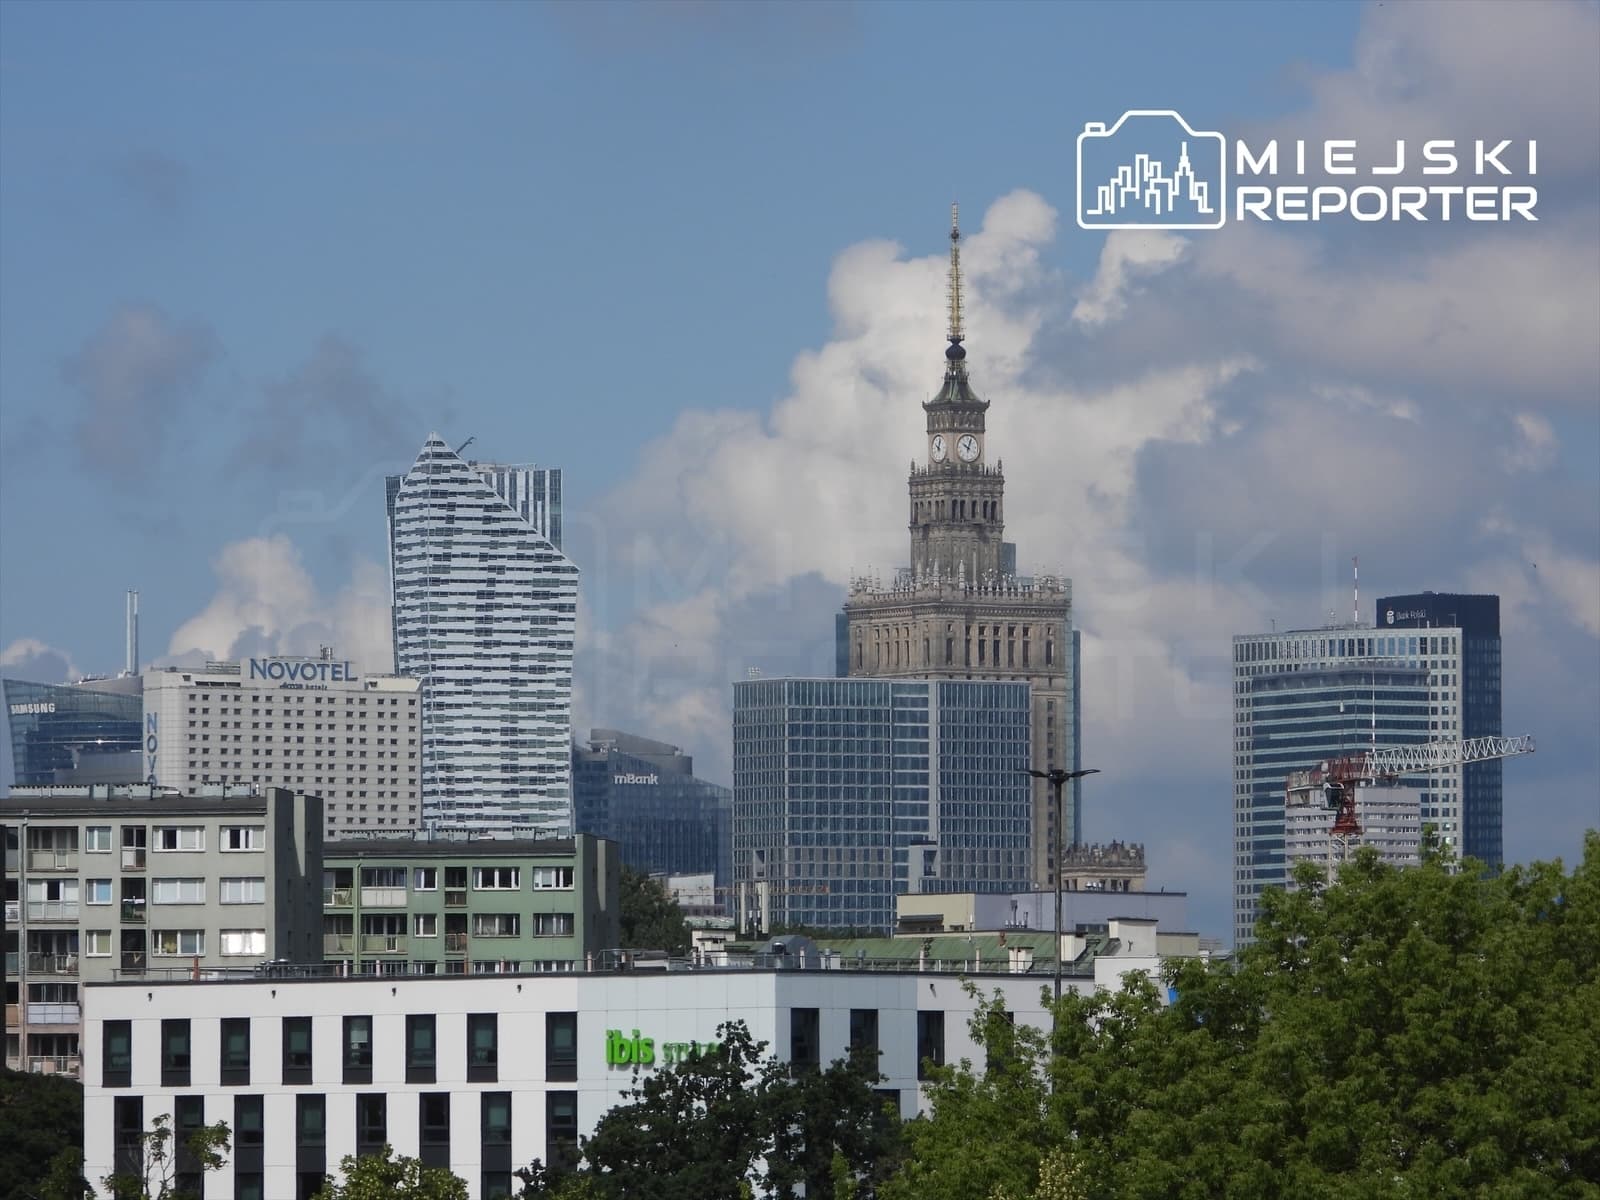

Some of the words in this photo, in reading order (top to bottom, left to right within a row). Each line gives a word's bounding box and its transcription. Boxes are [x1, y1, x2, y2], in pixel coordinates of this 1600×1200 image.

[249, 658, 359, 681] NOVOTEL
[11, 703, 56, 715] SAMSUNG
[614, 773, 659, 785] mBank
[606, 1029, 655, 1065] ibis
